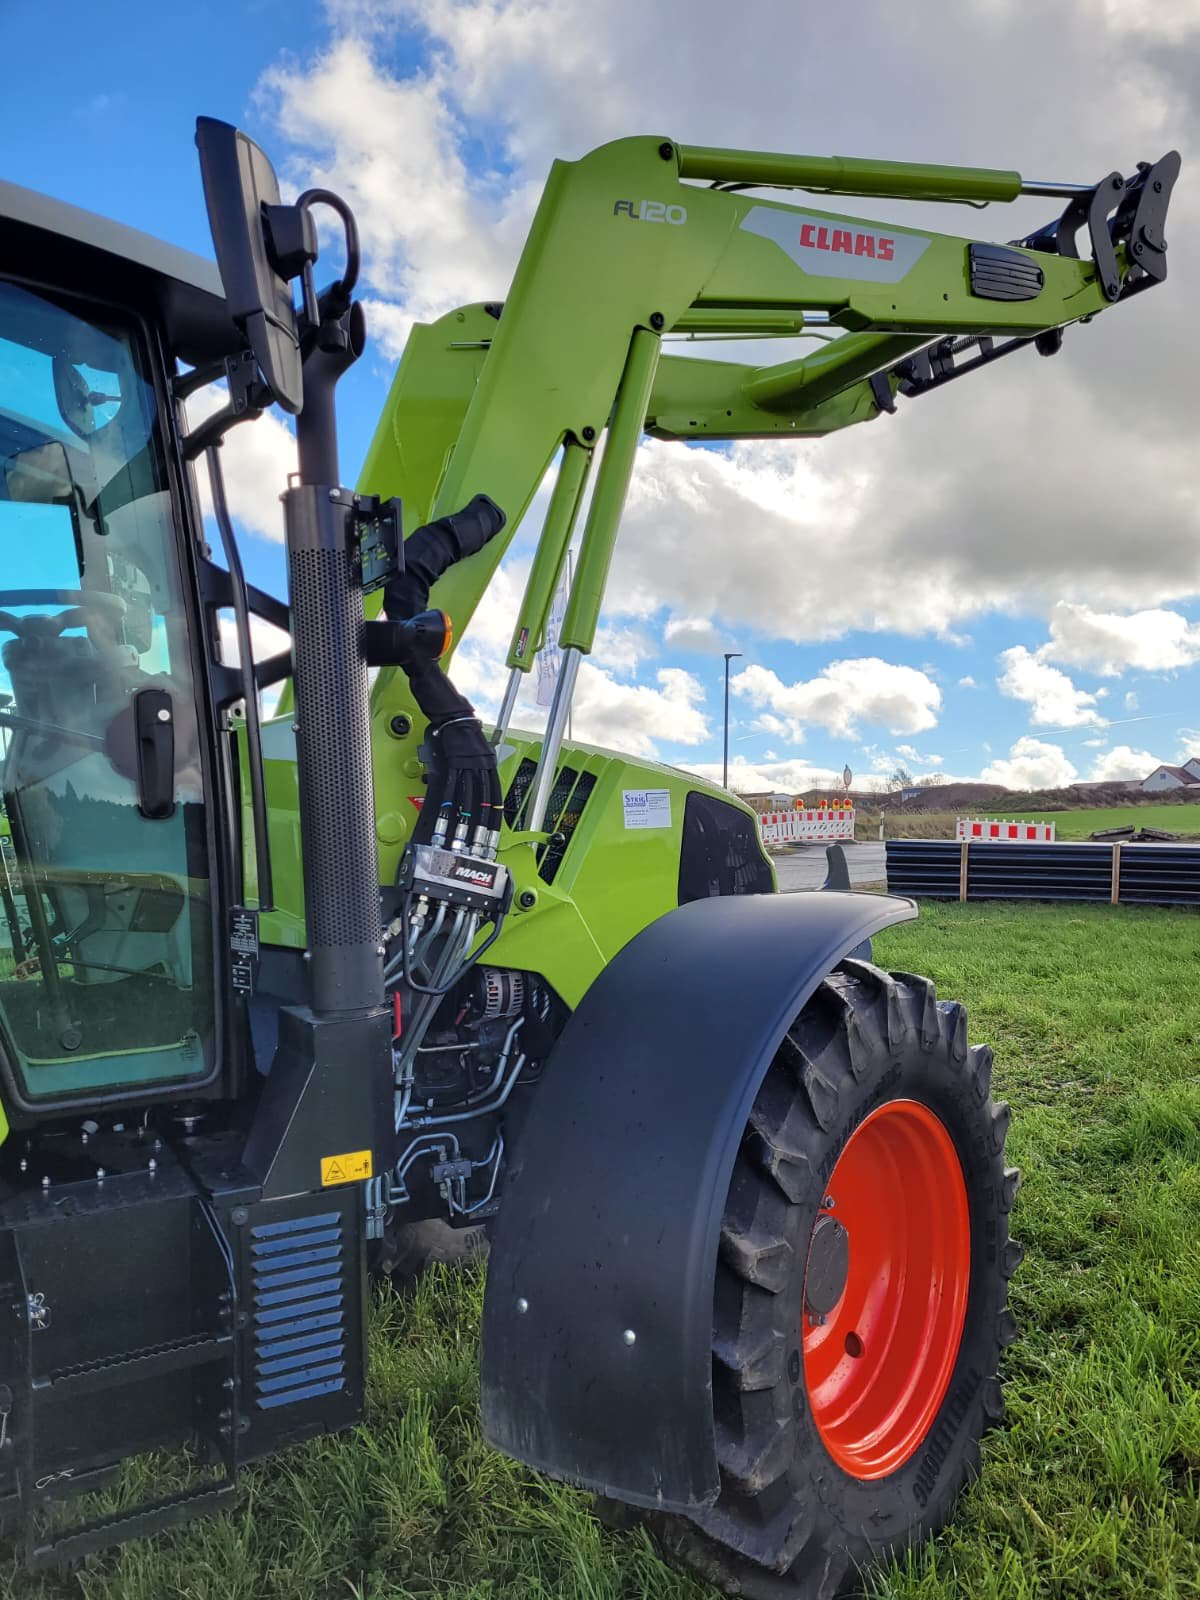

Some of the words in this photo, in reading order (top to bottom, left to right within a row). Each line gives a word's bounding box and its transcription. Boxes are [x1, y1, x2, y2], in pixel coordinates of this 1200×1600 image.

[613, 200, 688, 226] FL120
[799, 223, 895, 262] CLAAS
[455, 867, 492, 883] MACH
